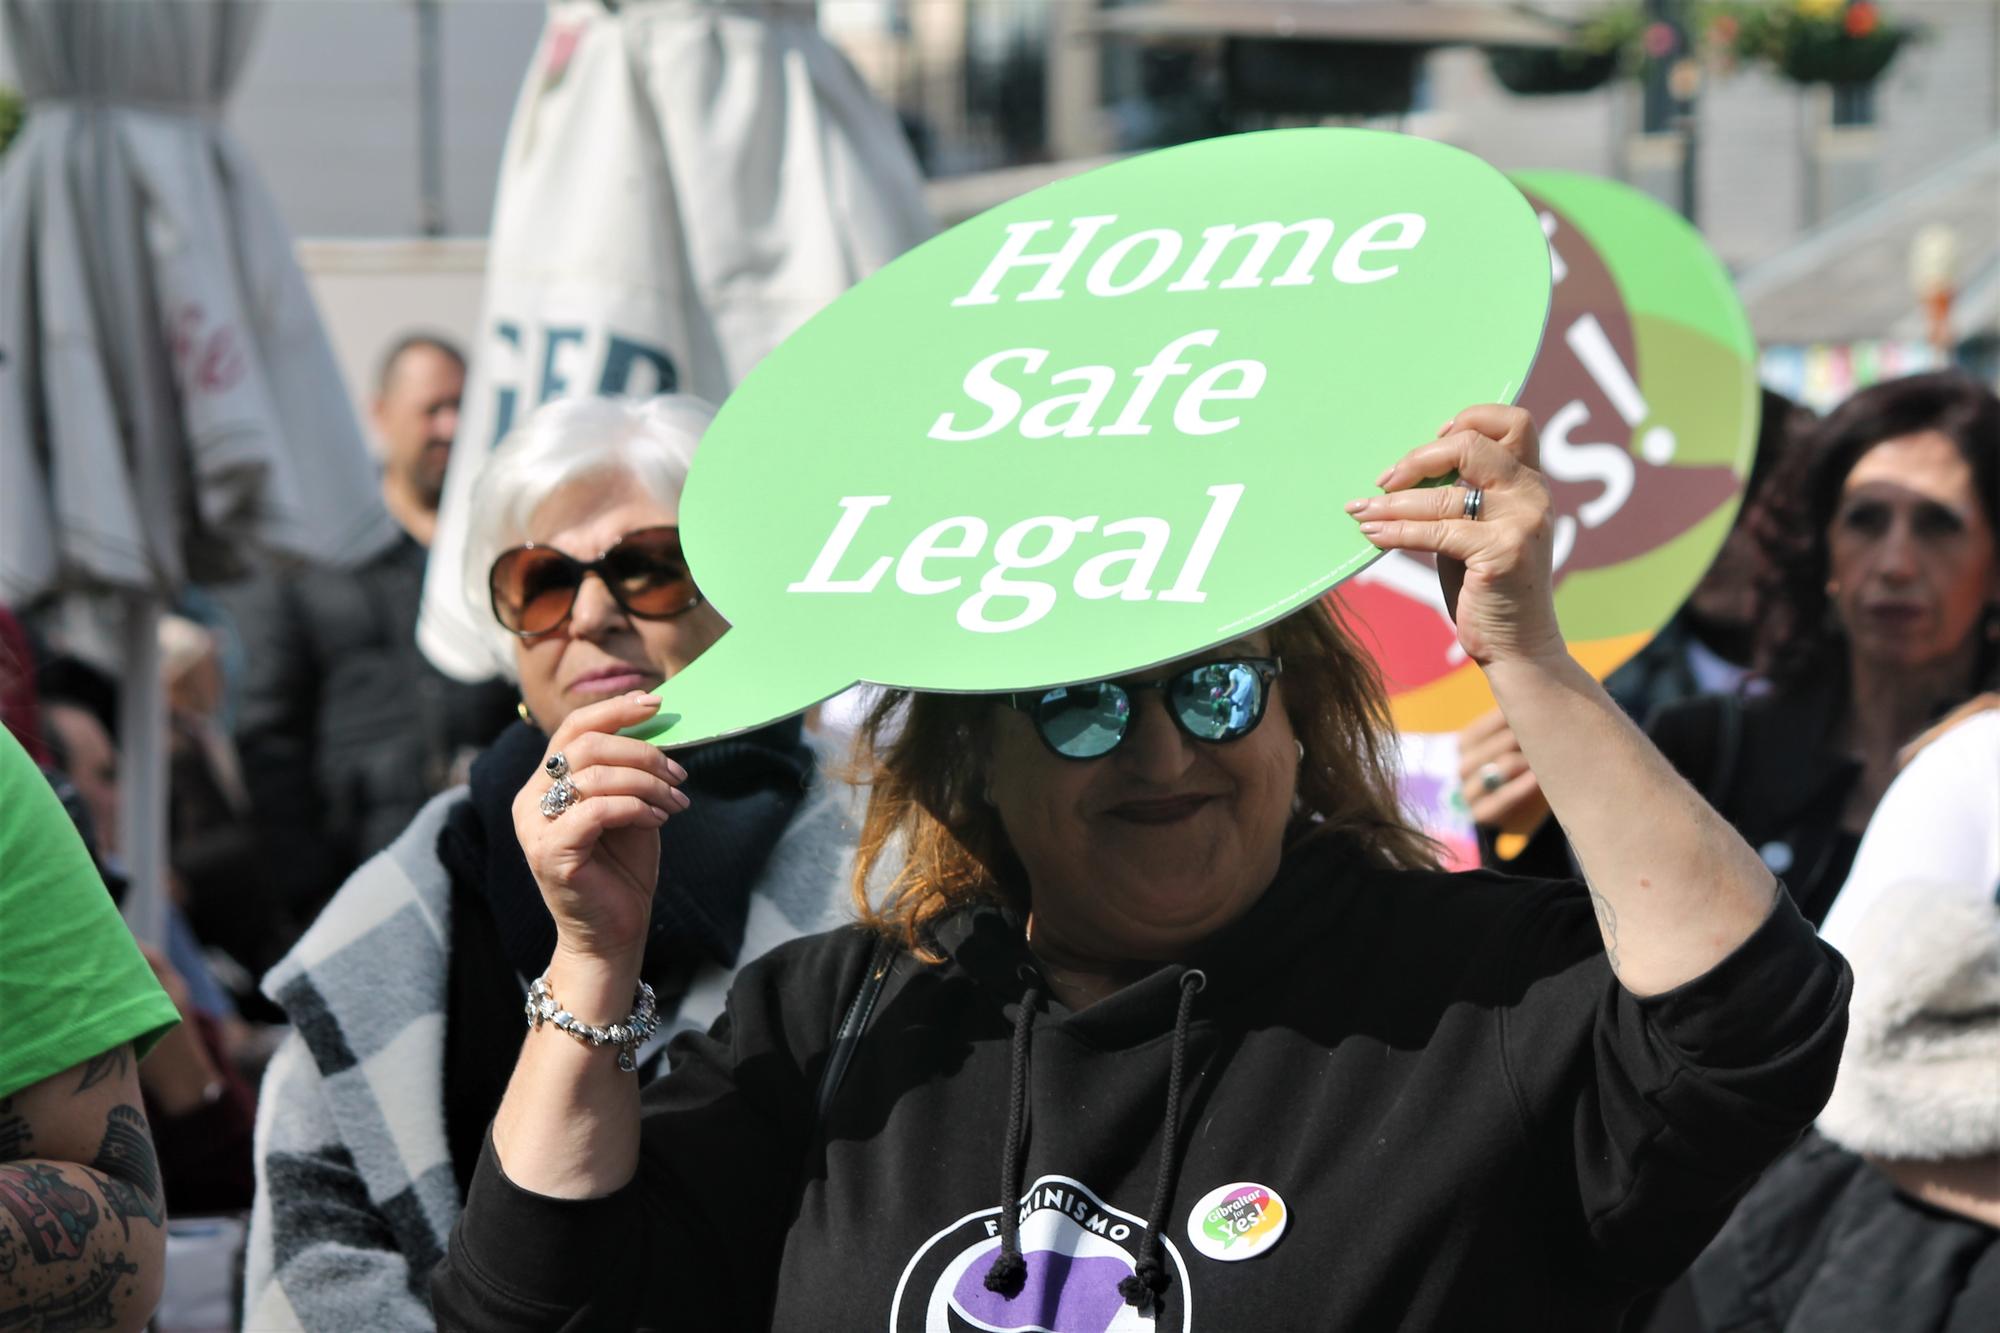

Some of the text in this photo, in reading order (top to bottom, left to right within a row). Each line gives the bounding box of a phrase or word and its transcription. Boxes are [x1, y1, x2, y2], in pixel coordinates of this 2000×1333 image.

[952, 212, 1427, 307] Home
[928, 328, 1268, 442] Safe
[787, 482, 1246, 634] Legal
[983, 1186, 1131, 1242] FMINISMO
[1207, 1189, 1261, 1224] Gibraltar
[1217, 1203, 1268, 1240] Yes!
[1232, 1207, 1246, 1221] for
